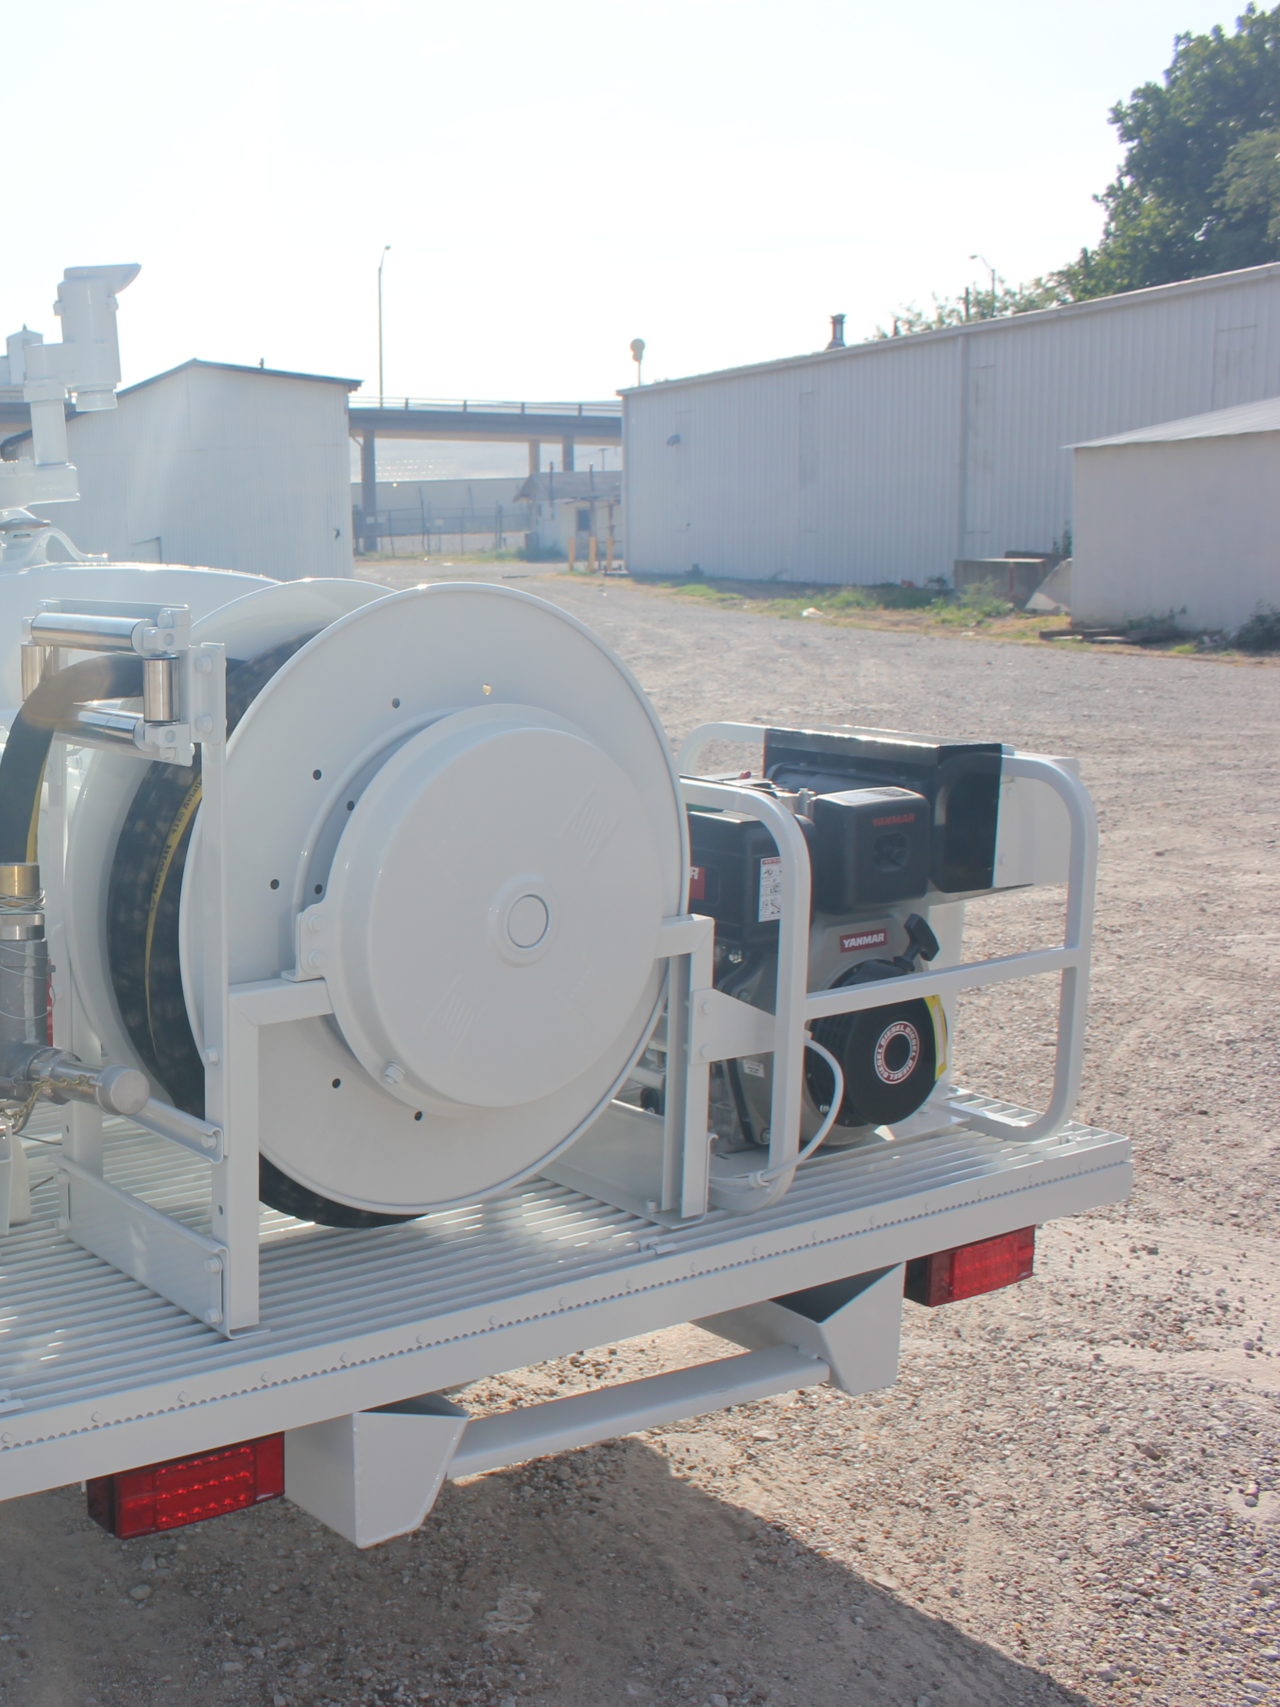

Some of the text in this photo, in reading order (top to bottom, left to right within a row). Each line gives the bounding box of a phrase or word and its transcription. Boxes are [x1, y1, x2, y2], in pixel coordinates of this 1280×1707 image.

[873, 813, 915, 827] YANMAR
[842, 933, 884, 948] YANMAR
[877, 1025, 917, 1080] DIESEL DIESEL DIESEL DIESEL
